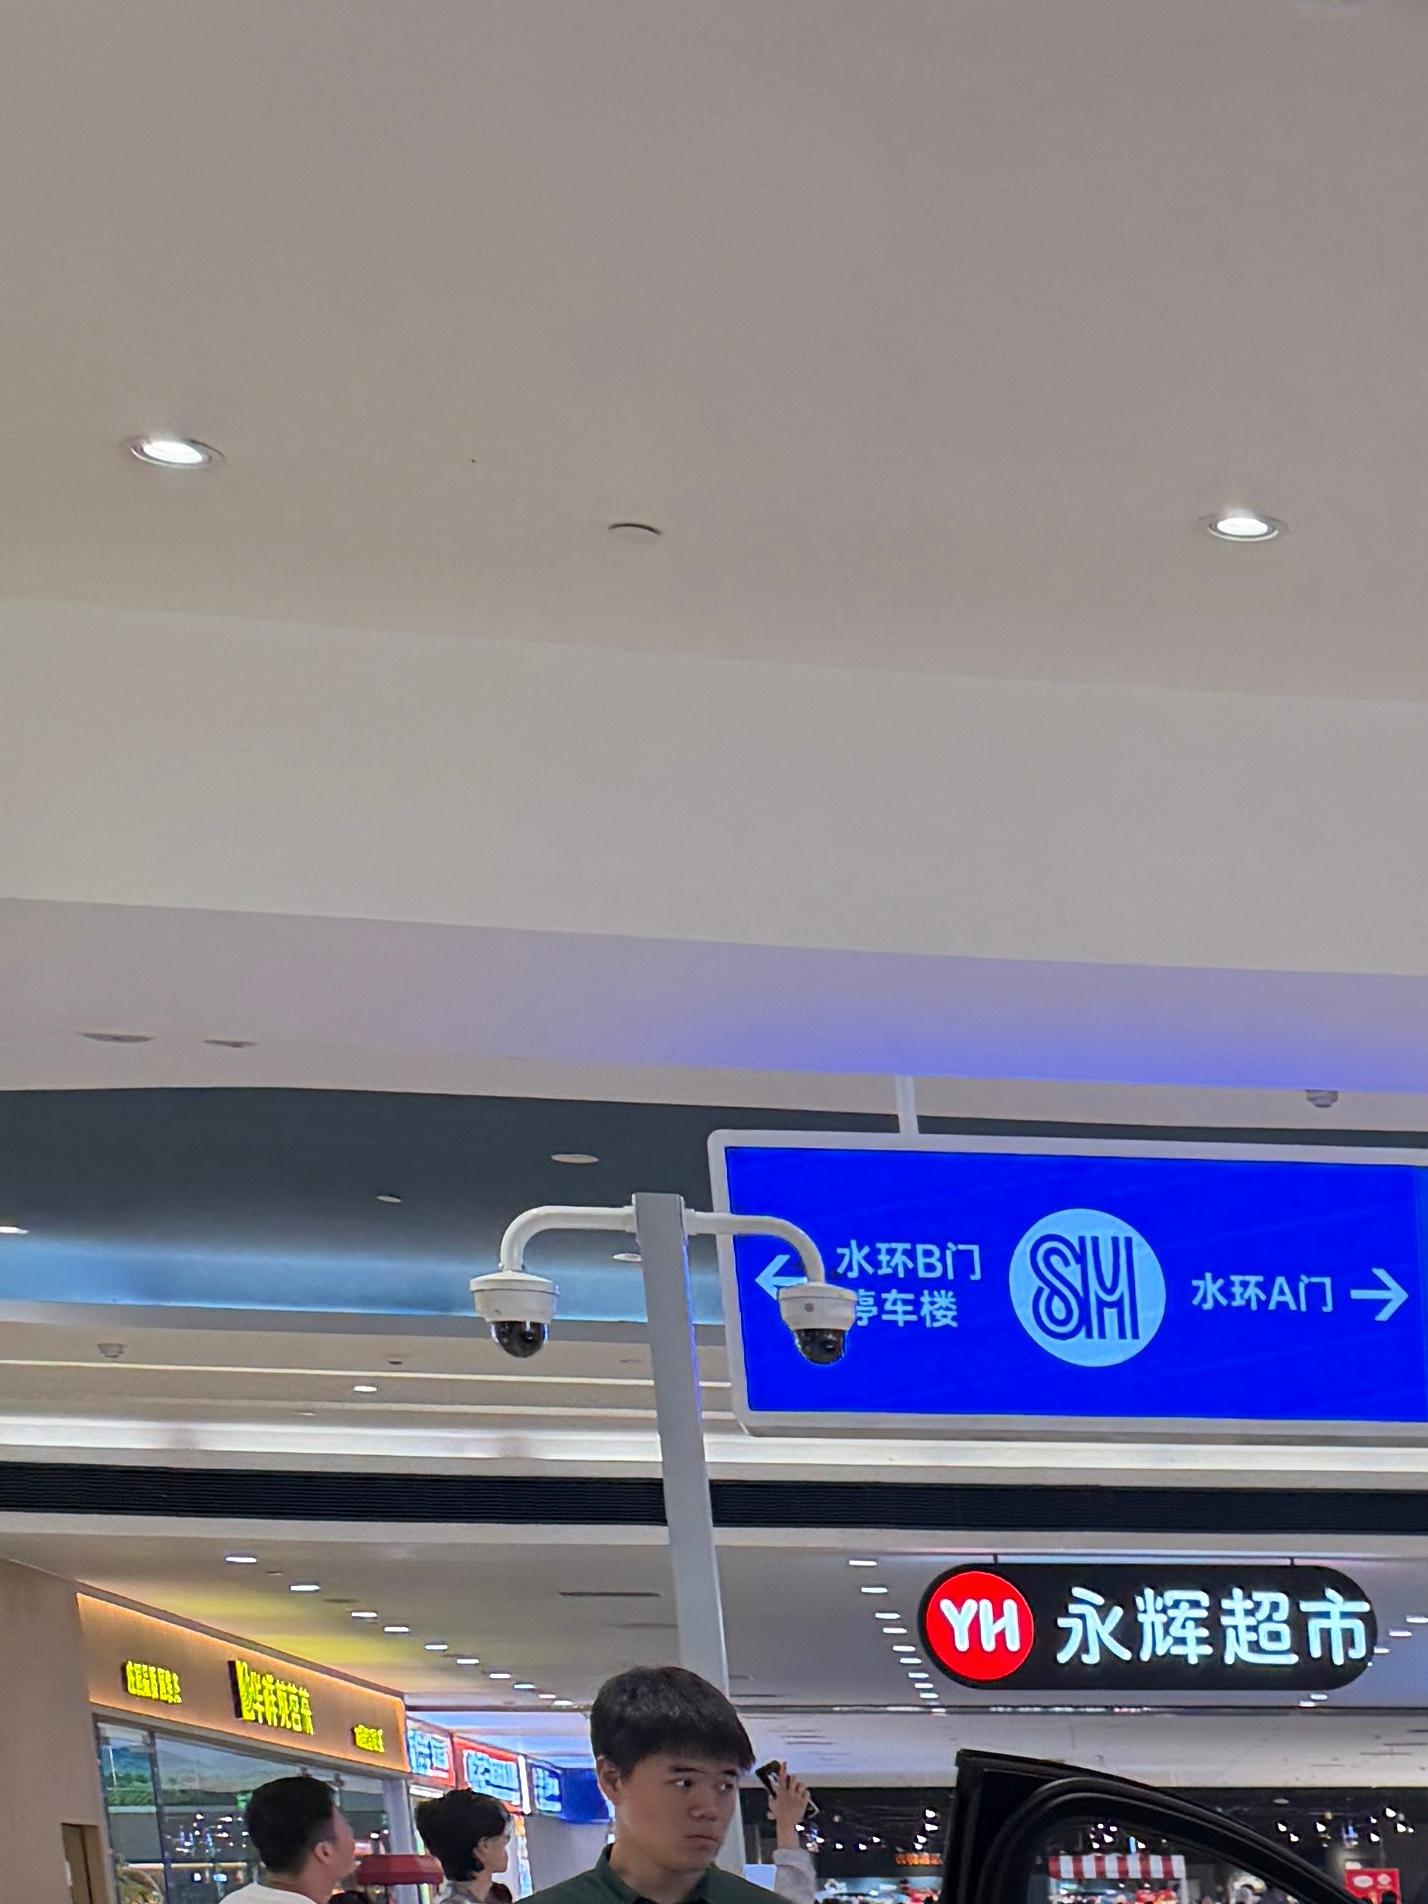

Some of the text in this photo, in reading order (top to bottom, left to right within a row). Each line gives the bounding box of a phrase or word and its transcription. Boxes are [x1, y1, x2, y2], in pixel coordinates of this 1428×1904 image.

[836, 1240, 982, 1284] 水环B门
[1191, 1271, 1334, 1314] 水环A门
[940, 1586, 1371, 1667] YH 永辉超市
